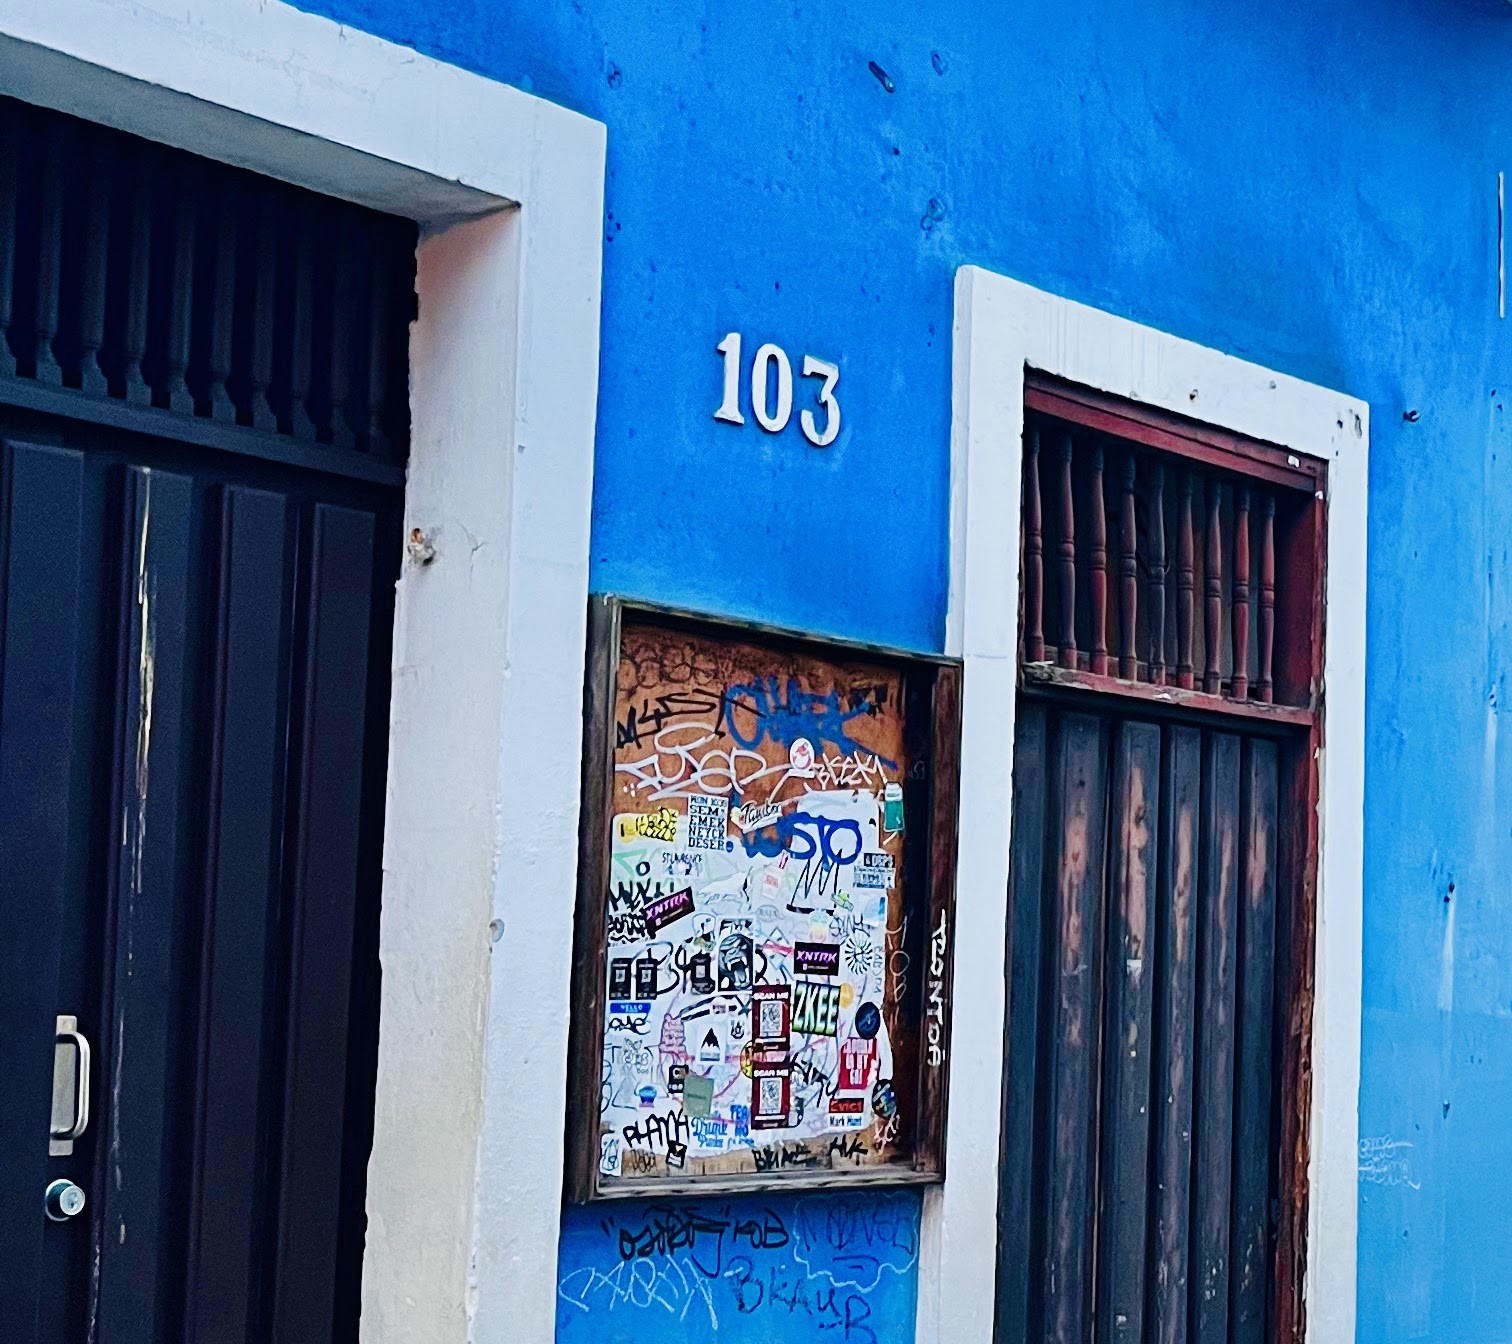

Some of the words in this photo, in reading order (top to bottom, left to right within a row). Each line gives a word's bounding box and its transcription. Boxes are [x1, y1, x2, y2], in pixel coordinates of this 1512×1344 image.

[714, 332, 841, 446] 103
[793, 982, 840, 1034] ZKEE
[830, 1116, 845, 1126] Mark
